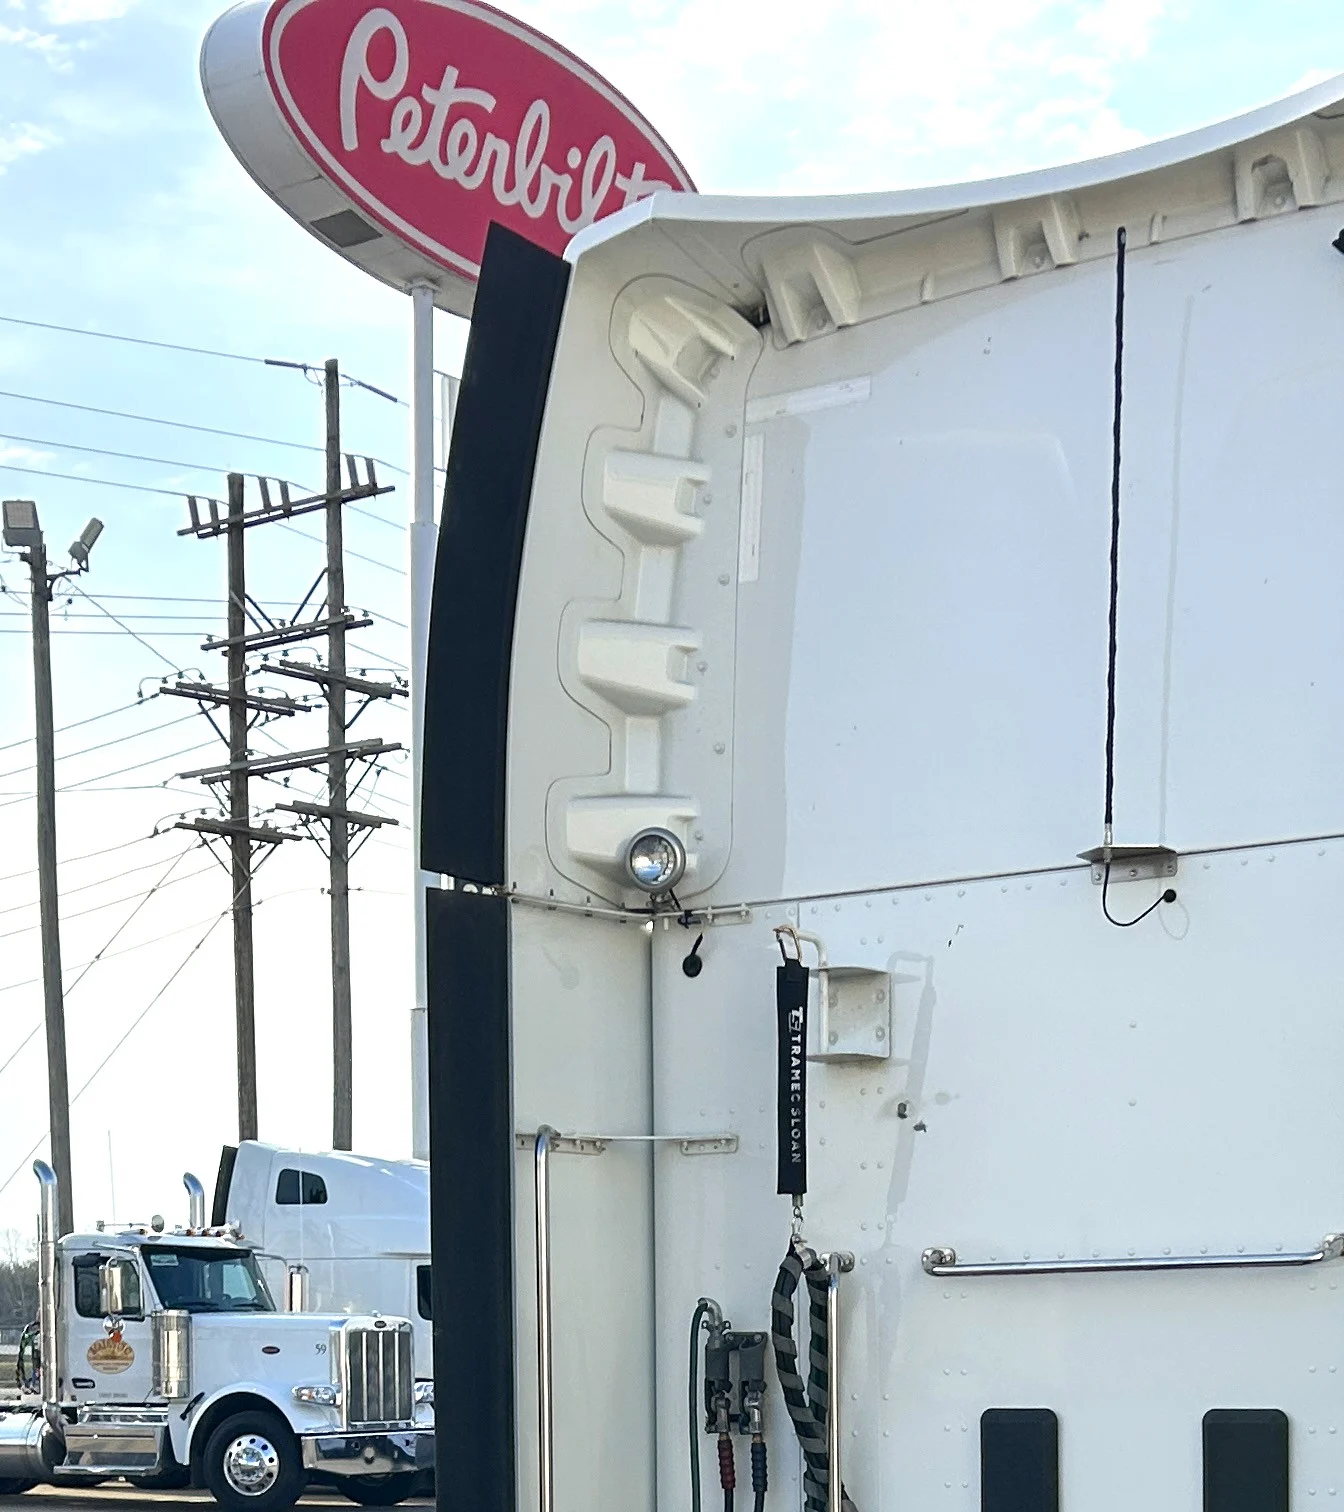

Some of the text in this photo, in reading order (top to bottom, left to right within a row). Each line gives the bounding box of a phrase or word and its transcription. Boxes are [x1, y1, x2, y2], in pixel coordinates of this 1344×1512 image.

[340, 7, 672, 234] Peterbilt
[790, 1034, 802, 1163] TRAMEC SLOAN
[316, 1344, 327, 1355] 59
